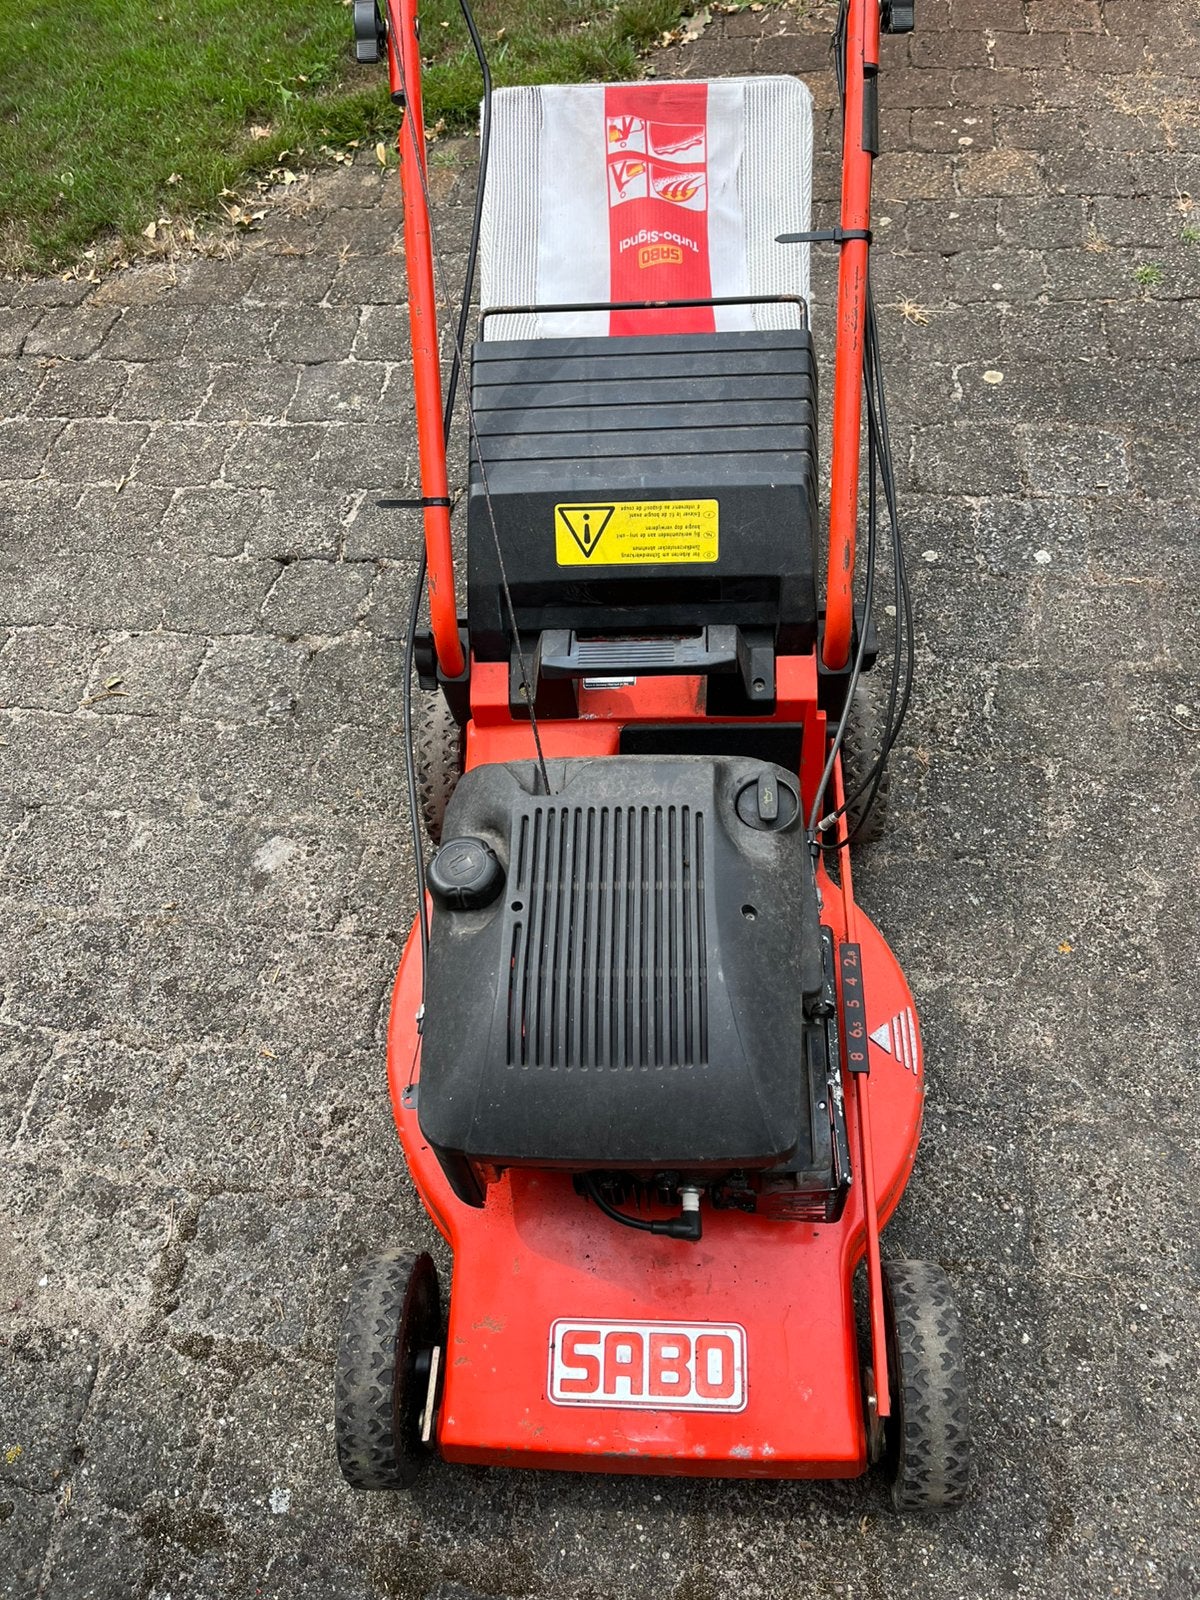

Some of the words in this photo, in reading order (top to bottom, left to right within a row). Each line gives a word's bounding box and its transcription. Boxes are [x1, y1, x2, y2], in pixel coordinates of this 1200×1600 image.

[619, 229, 699, 253] Turbo-Signal
[642, 247, 680, 264] SABO
[843, 950, 858, 967] 2,8
[845, 977, 858, 986] 4
[847, 999, 860, 1008] 5
[849, 1021, 864, 1038] 6,5
[849, 1052, 864, 1061] 8
[560, 1329, 735, 1398] SABO
